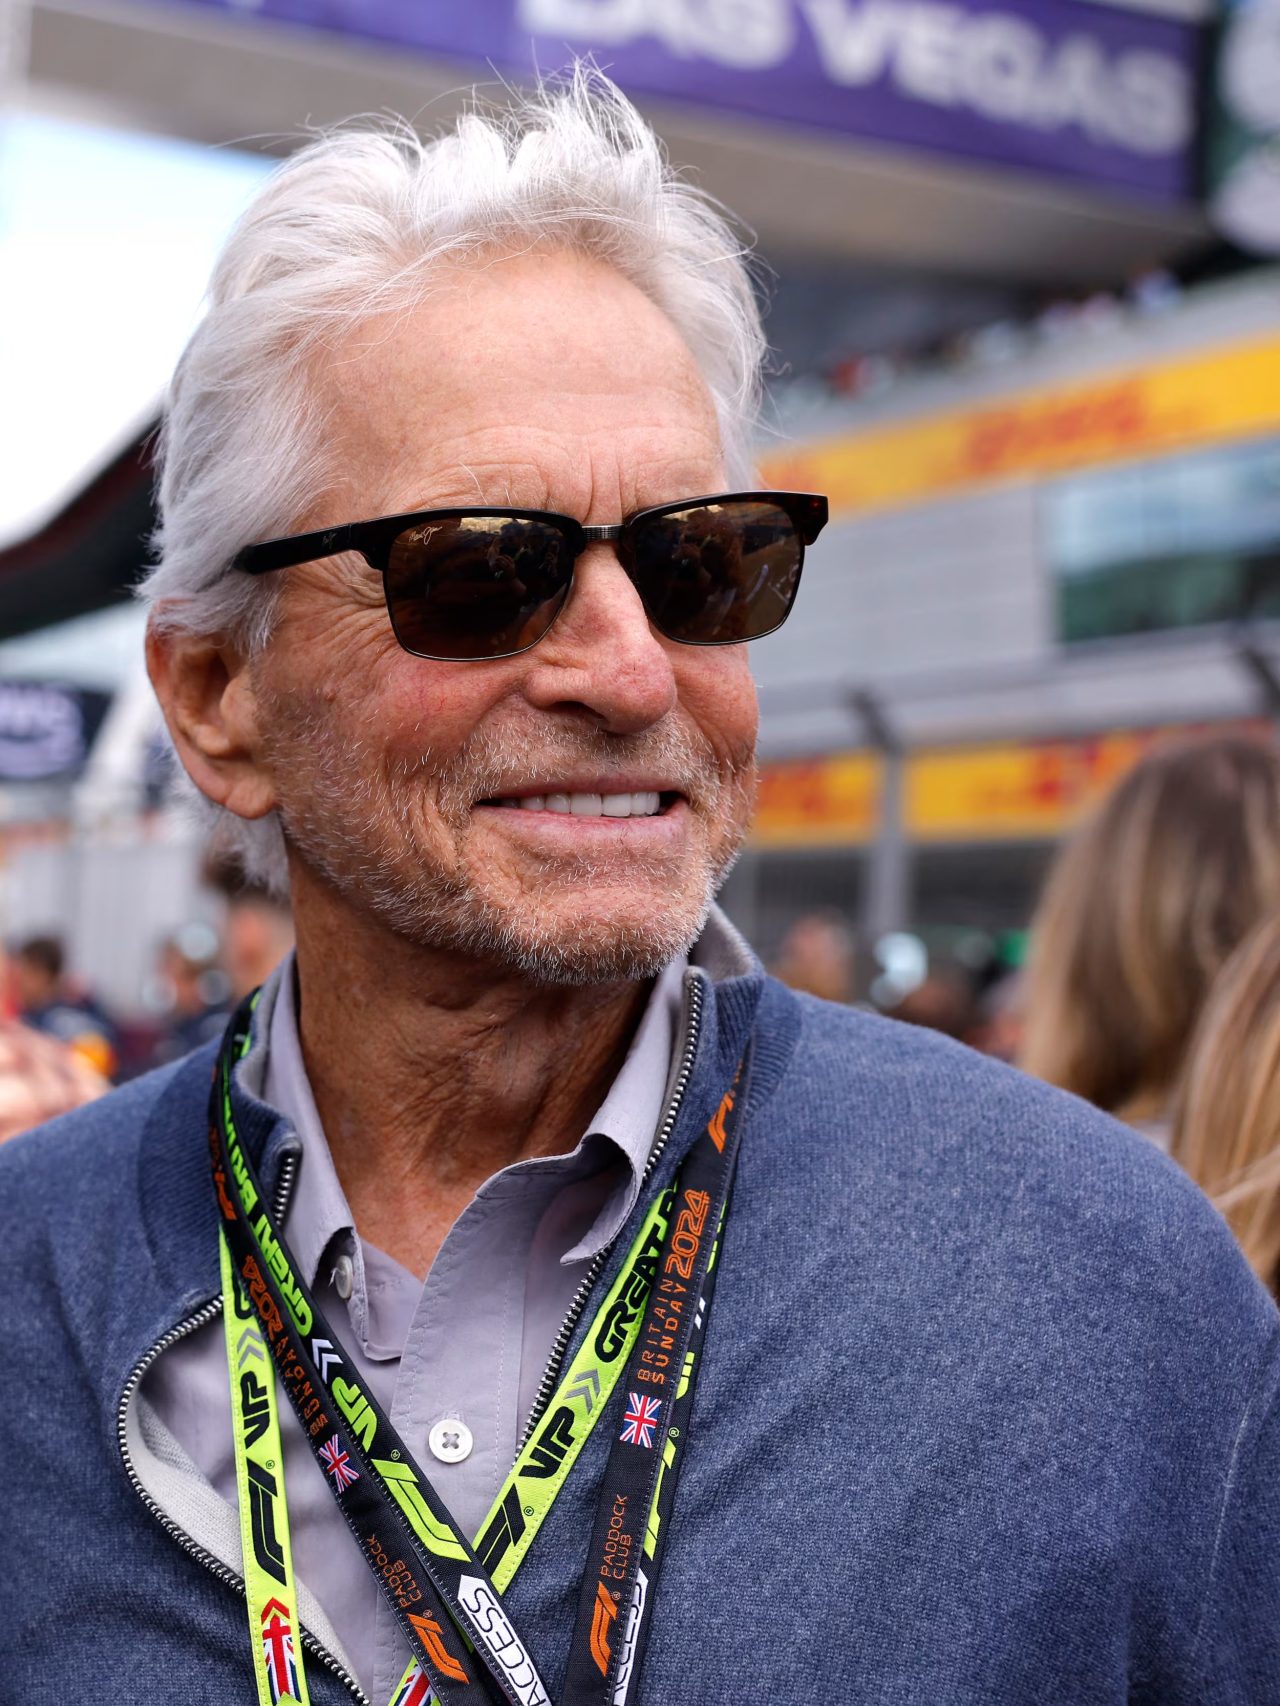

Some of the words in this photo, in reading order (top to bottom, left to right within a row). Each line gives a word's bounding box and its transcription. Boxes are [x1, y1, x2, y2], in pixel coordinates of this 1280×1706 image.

[804, 0, 1195, 156] VEGAS
[250, 1214, 313, 1336] GREAT
[665, 1188, 711, 1281] 2024
[242, 1254, 284, 1341] 2024
[637, 1279, 674, 1381] BRITAIN
[651, 1283, 689, 1385] SUNDAY
[240, 1370, 270, 1449] VIP
[332, 1376, 378, 1453] VIP
[519, 1405, 575, 1480] VIP
[366, 1534, 411, 1608] PADDOCK
[601, 1494, 628, 1577] PADDOCK
[613, 1534, 632, 1580] CLUB
[393, 1559, 422, 1602] CLUB
[462, 1586, 548, 1706] ACCESS
